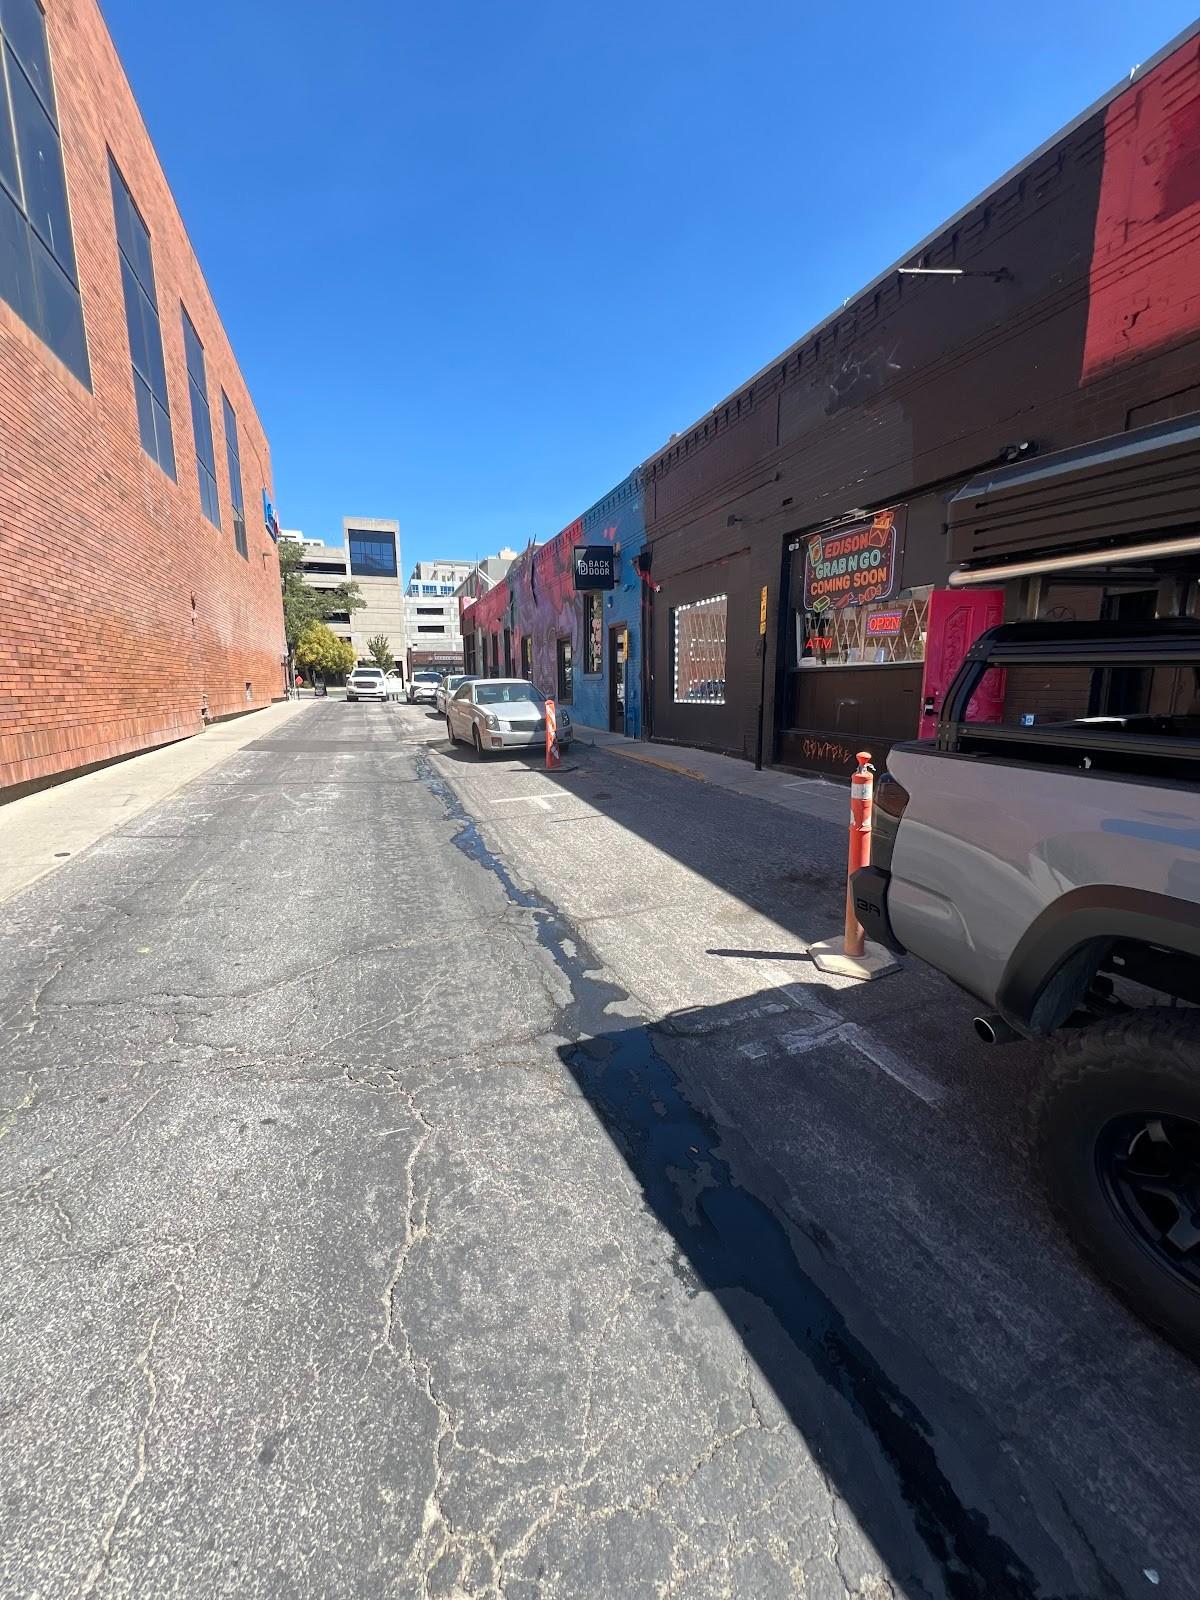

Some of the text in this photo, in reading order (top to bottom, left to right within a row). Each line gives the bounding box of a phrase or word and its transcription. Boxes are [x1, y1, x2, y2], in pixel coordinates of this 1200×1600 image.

[825, 533, 869, 558] EDISON
[589, 560, 610, 568] BACK
[816, 559, 846, 579] GRAB
[859, 549, 881, 568] GO
[811, 567, 887, 596] COMING SOON
[869, 616, 900, 631] OPEN
[806, 637, 832, 649] ATM
